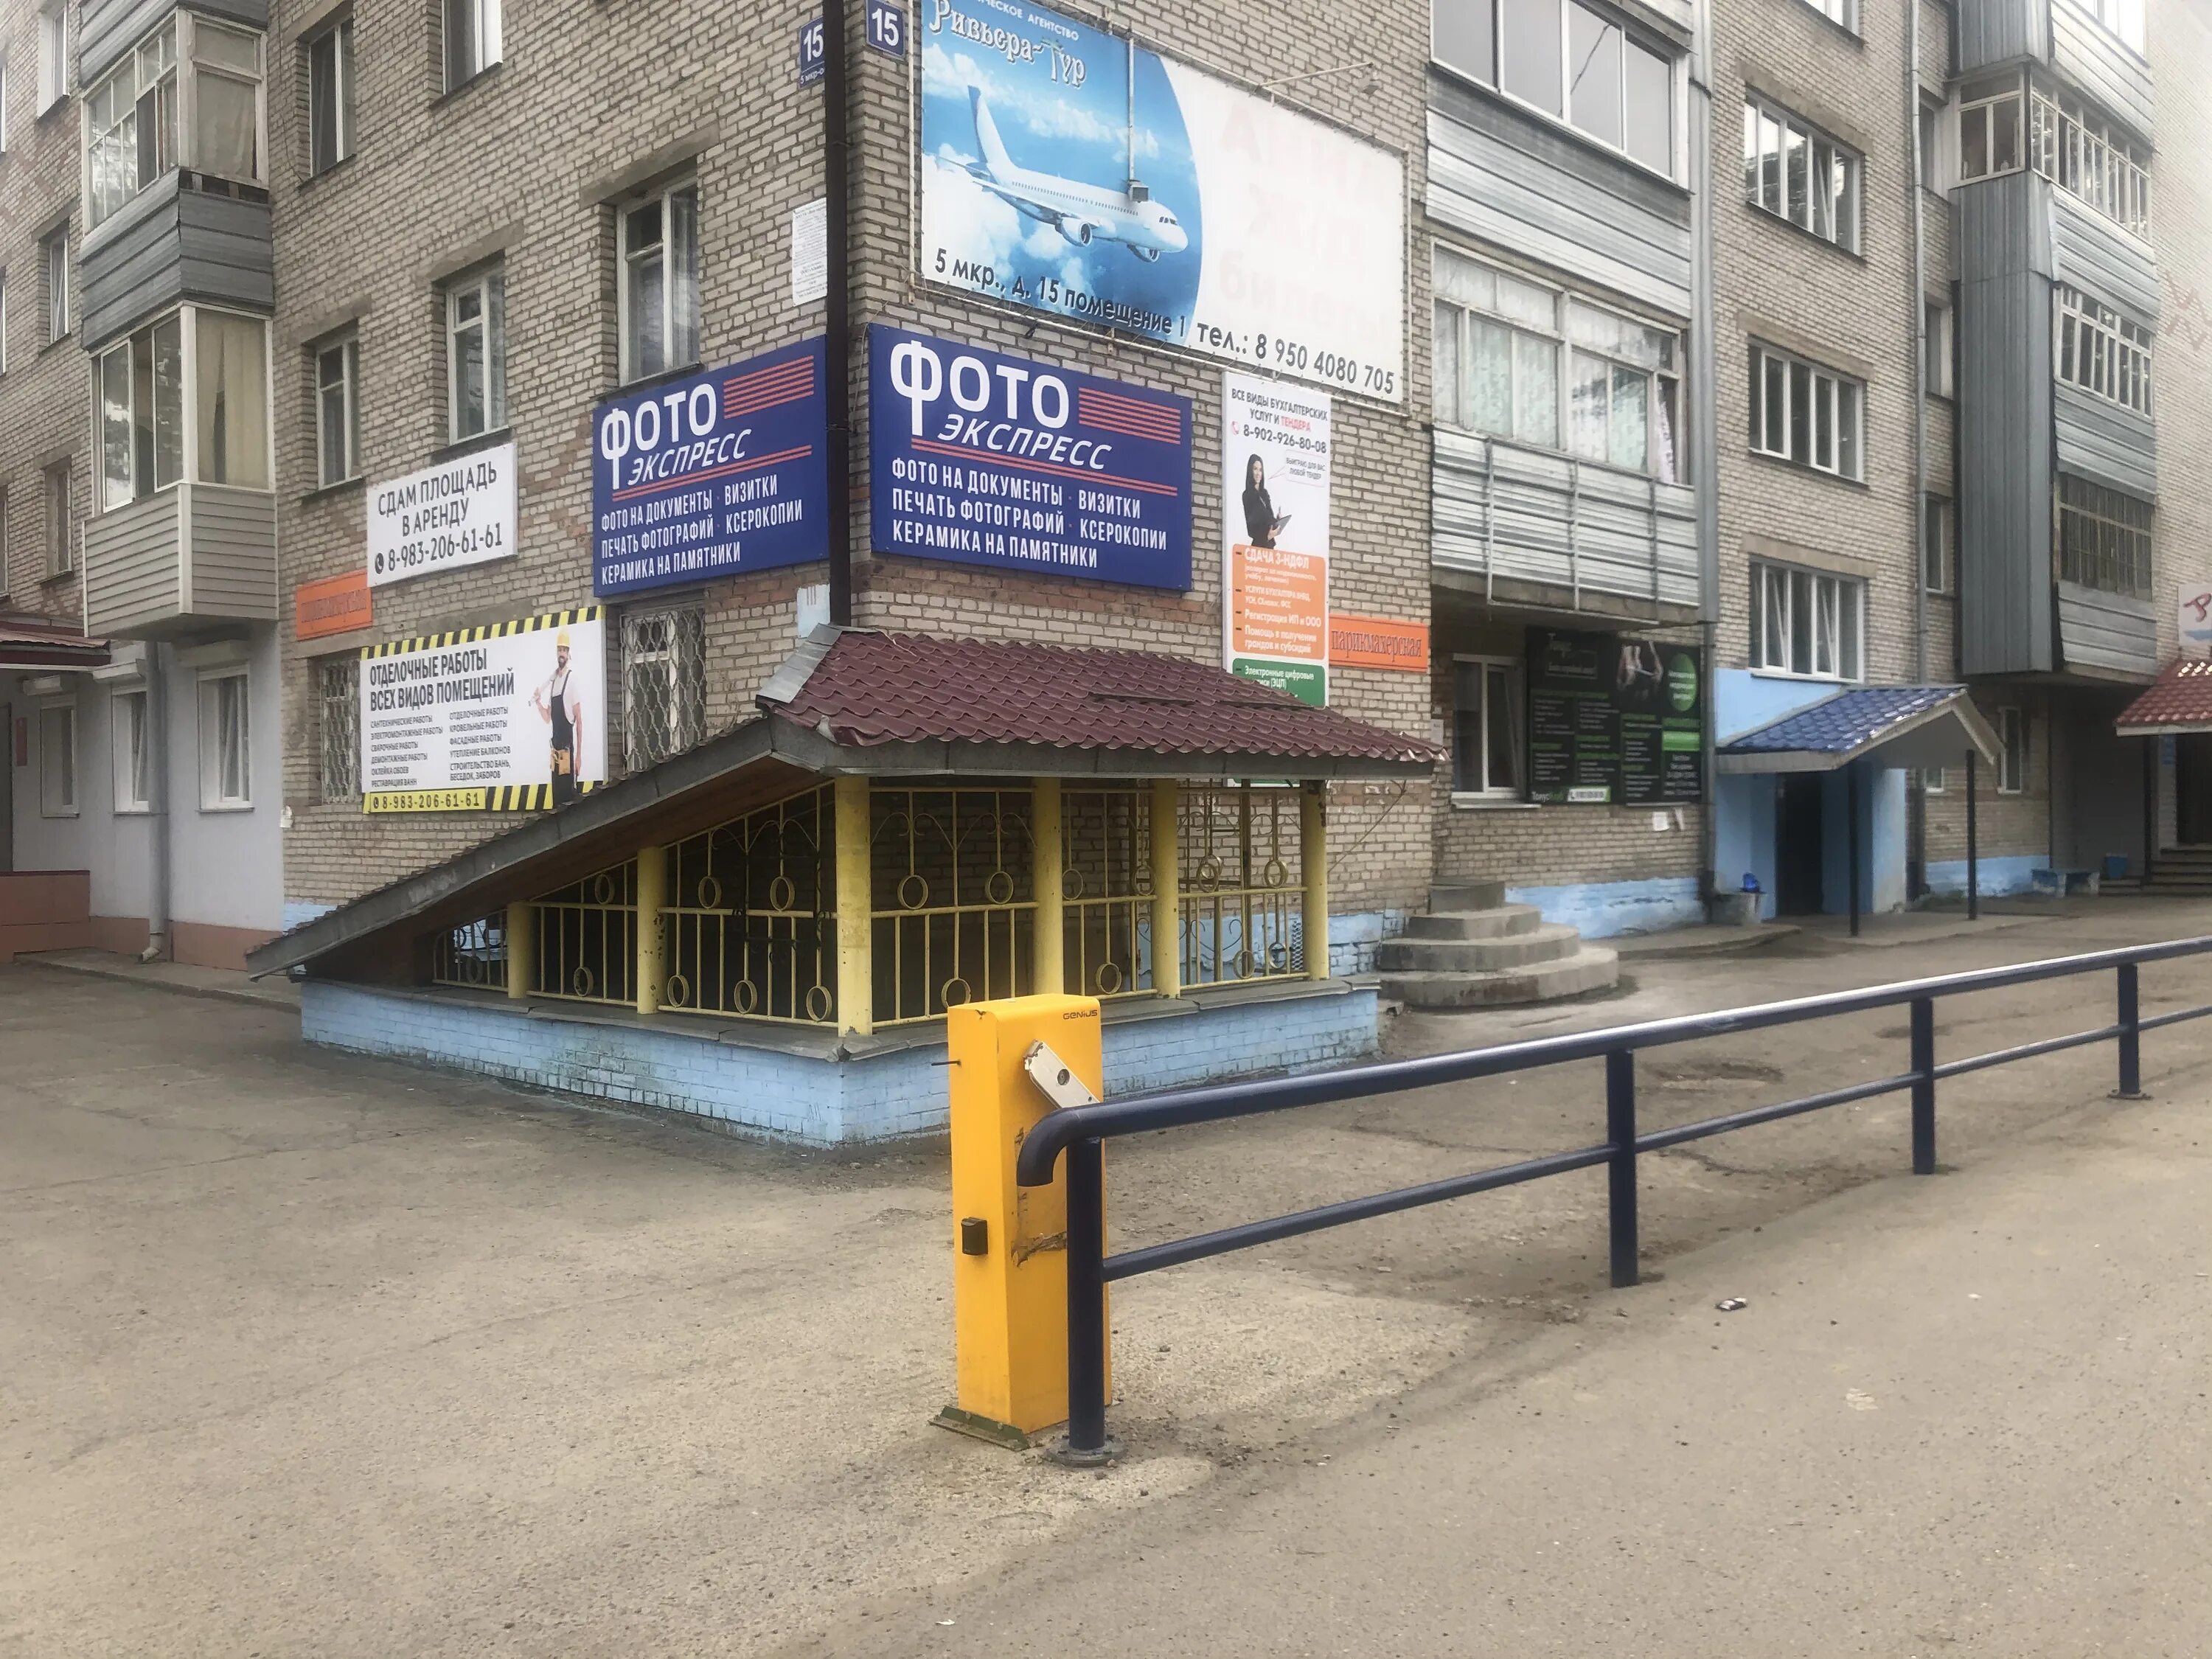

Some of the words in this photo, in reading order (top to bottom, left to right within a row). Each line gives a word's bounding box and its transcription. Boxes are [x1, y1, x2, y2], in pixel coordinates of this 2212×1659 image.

[803, 23, 824, 63] 15
[872, 8, 900, 46] 15
[1028, 12, 1079, 41] АГЕНТСТВО
[935, 248, 947, 273] 5
[952, 259, 1006, 292] мкр.,
[1012, 276, 1032, 299] д.
[1040, 276, 1060, 304] 15
[1065, 288, 1172, 334] помещение
[1179, 316, 1185, 337] 1
[1197, 322, 1249, 354] тел.:
[1255, 334, 1267, 359] 8
[1276, 338, 1307, 371] 950
[1314, 352, 1357, 384] 4080
[1365, 365, 1394, 395] 705
[890, 339, 1069, 437] ФОТО
[1231, 388, 1245, 401] ВСЕ
[1247, 392, 1269, 408] ВИДЫ
[1270, 397, 1328, 421] БУХГАЛТЕРСКИХ
[601, 383, 717, 490] ФОТО
[1250, 408, 1273, 423] УСЛУГ
[1274, 414, 1280, 424] И
[1281, 416, 1312, 432] ТЕНДЕРА
[937, 413, 1113, 470] ЭКСПРЕСС
[1243, 424, 1327, 453] 8-902-926-80-08
[627, 429, 751, 485] ЭКСПРЕСС
[378, 484, 416, 517] СДАМ
[421, 461, 497, 503] ПЛОЩАДЬ
[602, 508, 627, 532] ФОТО
[630, 506, 643, 525] НА
[646, 489, 713, 524] ДОКУМЕНТЫ
[725, 474, 778, 506] ВИЗИТКИ
[892, 457, 938, 485] ФОТО
[942, 465, 963, 490] НА
[967, 470, 1062, 507] ДОКУМЕНТЫ
[1079, 489, 1141, 519] ВИЗИТКИ
[403, 515, 411, 537] В
[413, 498, 469, 534] АРЕНДУ
[602, 534, 639, 559] ПЕЧАТЬ
[641, 515, 714, 550] ФОТОГРАФИЙ
[726, 499, 802, 535] КСЕРОКОПИИ
[892, 487, 955, 518] ПЕЧАТЬ
[960, 498, 1065, 535] ФОТОГРАФИЙ
[1079, 518, 1166, 551] КСЕРОКОПИИ
[388, 522, 502, 571] 8-983-206-61-61
[893, 520, 981, 553] КЕРАМИКА
[986, 532, 1005, 556] НА
[1009, 537, 1098, 568] ПАМЯТНИКИ
[1245, 548, 1274, 563] СДАЧА
[602, 557, 655, 585] КЕРАМИКА
[657, 554, 671, 574] НА
[673, 542, 741, 570] ПАМЯТНИКИ
[1245, 608, 1287, 624] Регистрация
[1289, 613, 1298, 625] ИП
[1306, 616, 1321, 627] ООО
[1245, 625, 1274, 639] Помощь
[370, 656, 439, 688] ОТДЕЛОЧНЫЕ
[442, 648, 487, 675] РАБОТЫ
[1245, 665, 1284, 678] Электронные
[1285, 669, 1314, 681] цифровые
[1271, 678, 1287, 690] (ЭЦП)
[370, 689, 396, 712] ВСЕХ
[398, 684, 434, 710] ВИДОВ
[437, 667, 515, 703] ПОМЕЩЕНИЙ
[414, 715, 432, 725] РАБОТЫ
[450, 709, 486, 720] ОТДЕЛОЧНЫЕ
[486, 707, 508, 715] РАБОТЫ
[450, 722, 485, 732] КРОВЕЛЬНЫЕ
[485, 720, 507, 729] РАБОТЫ
[422, 726, 443, 735] РАБОТЫ
[450, 735, 479, 745] ФАСАДНЫЕ
[479, 734, 501, 742] РАБОТЫ
[408, 753, 428, 761] РАБОТЫ
[450, 748, 480, 758] УТЕПЛЕНИЕ
[481, 746, 510, 755] БАЛКОНОВ
[451, 761, 494, 771] СТРОИТЕЛЬСТВО
[476, 771, 501, 779] ЗАБОРОВ
[382, 793, 481, 809] 8-983-206-61-61
